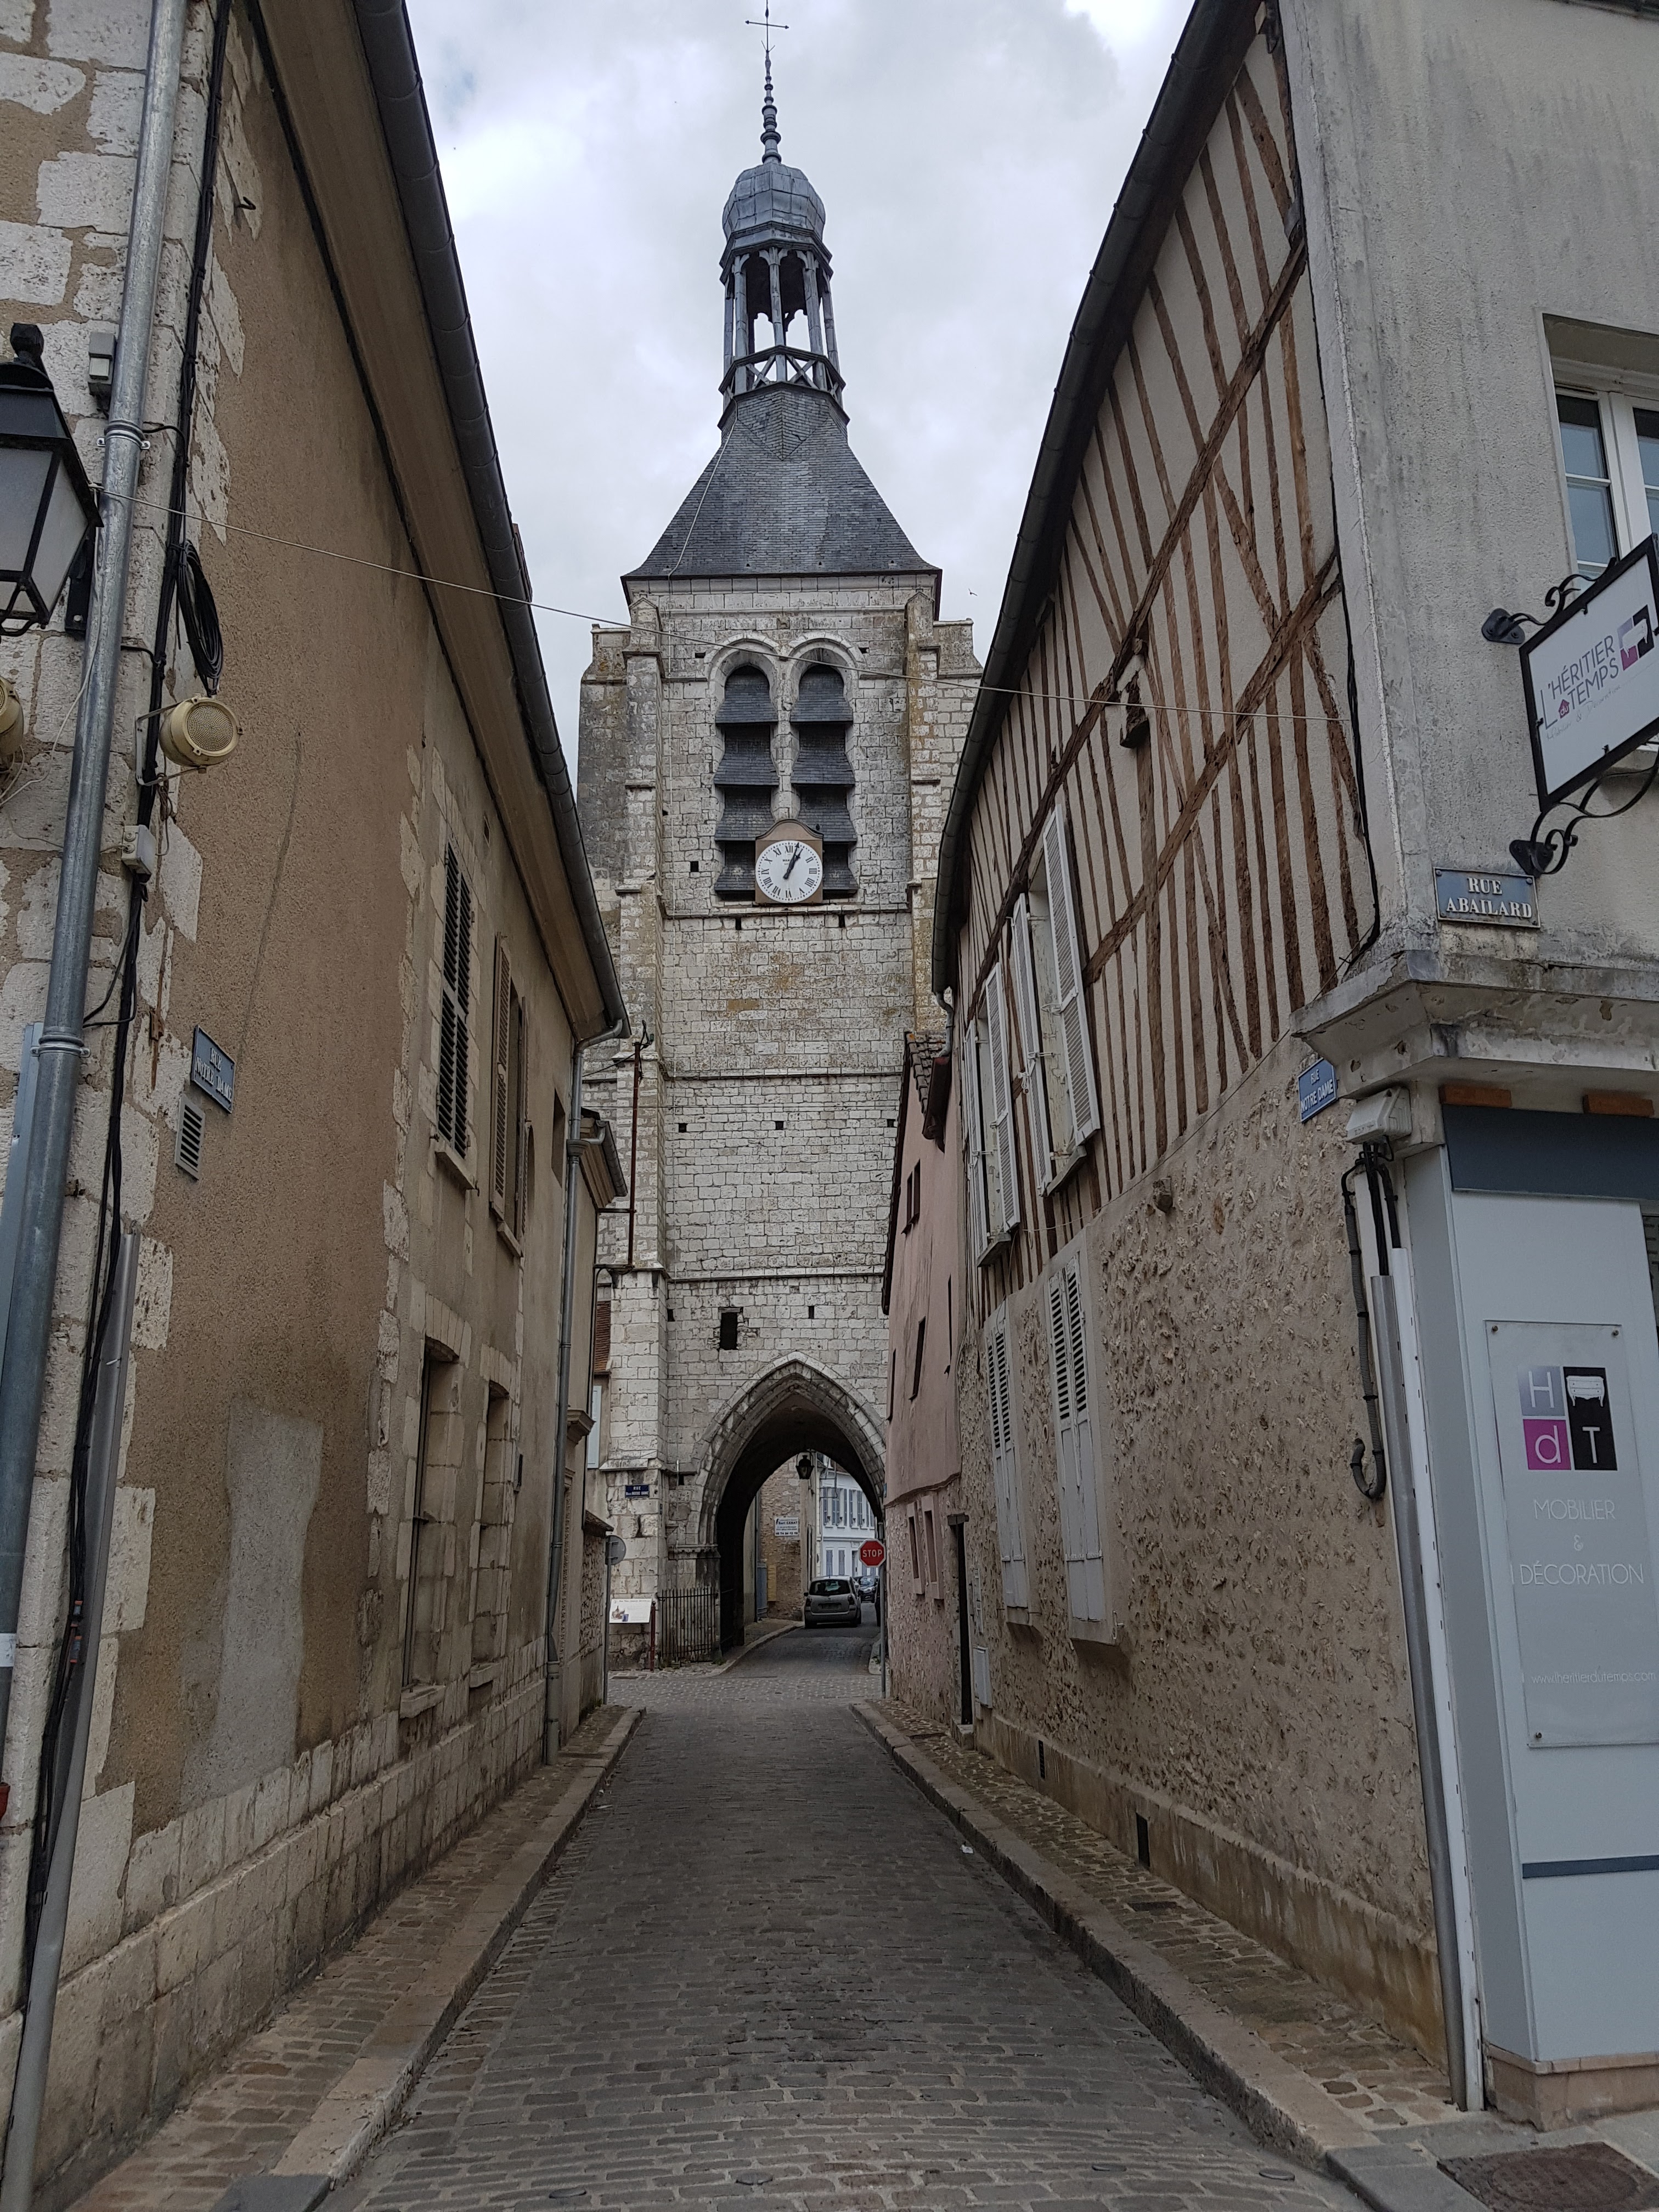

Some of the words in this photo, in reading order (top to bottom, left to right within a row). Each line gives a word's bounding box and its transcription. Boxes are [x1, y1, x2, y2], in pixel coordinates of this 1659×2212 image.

[1541, 635, 1615, 730] L'HÉRITIER
[1560, 705, 1569, 716] du
[1567, 657, 1619, 709] TEMPS
[773, 848, 781, 857] XI
[1467, 877, 1503, 895] RUE
[1446, 897, 1533, 918] ABAILARD
[210, 1047, 222, 1071] RUE
[195, 1057, 214, 1086] NOTRE
[216, 1075, 233, 1103] DAME
[1311, 1069, 1320, 1085] RUE
[1300, 1091, 1317, 1114] NOTRE
[1318, 1079, 1334, 1102] DAME
[1528, 1371, 1554, 1408] H
[1535, 1425, 1562, 1464] d
[1582, 1426, 1601, 1464] T
[1533, 1499, 1616, 1520] MOBILIER
[862, 1549, 883, 1558] STOP
[1573, 1534, 1583, 1551] &
[1520, 1561, 1644, 1585] DÉCORATION
